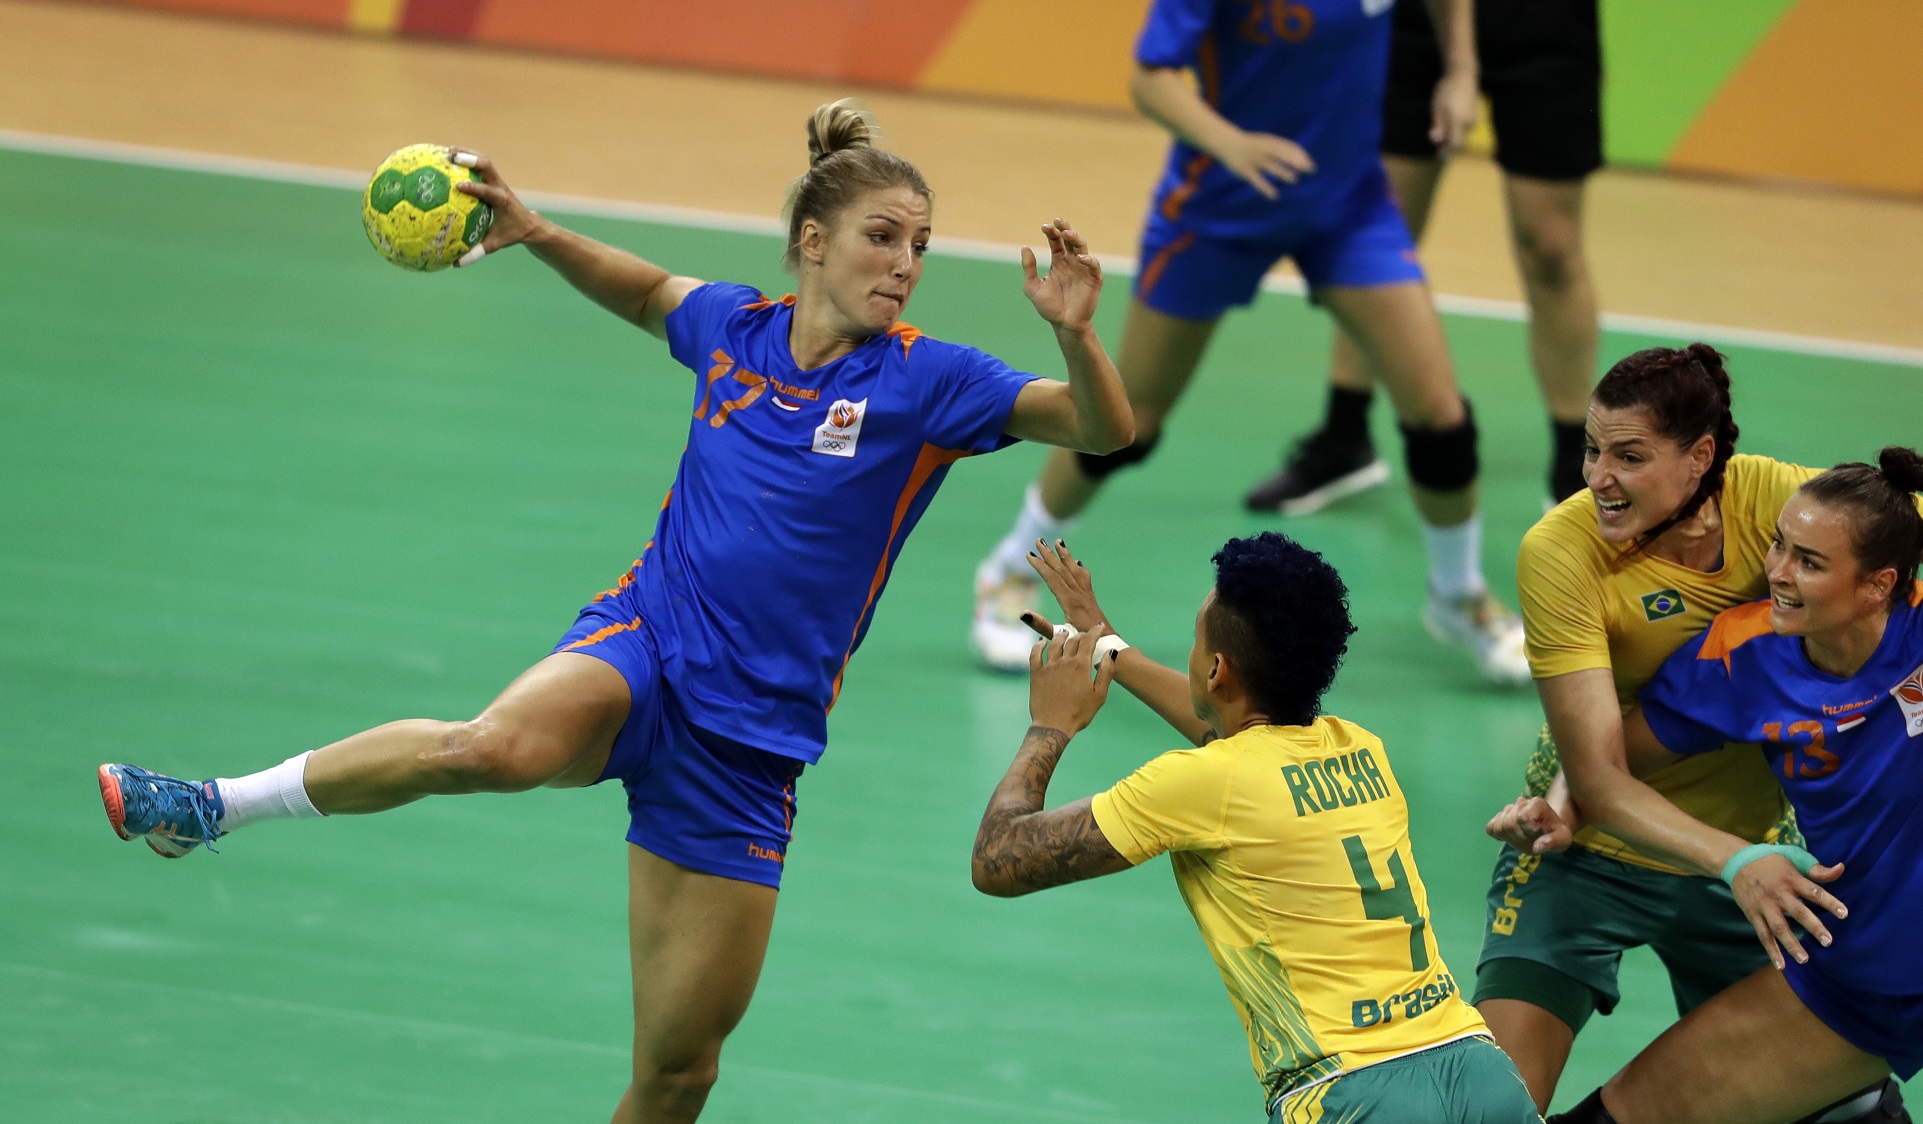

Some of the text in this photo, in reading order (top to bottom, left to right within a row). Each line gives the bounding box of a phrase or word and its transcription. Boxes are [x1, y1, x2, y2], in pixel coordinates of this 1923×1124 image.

[1238, 0, 1314, 45] 26
[693, 348, 767, 428] 17
[769, 375, 820, 401] hummel
[822, 430, 851, 440] TeamNL
[1761, 720, 1840, 779] 13
[1281, 748, 1391, 817] ROCHA
[1341, 834, 1429, 972] 4
[1492, 853, 1541, 936] Bras
[1351, 974, 1455, 1028] Brasil
